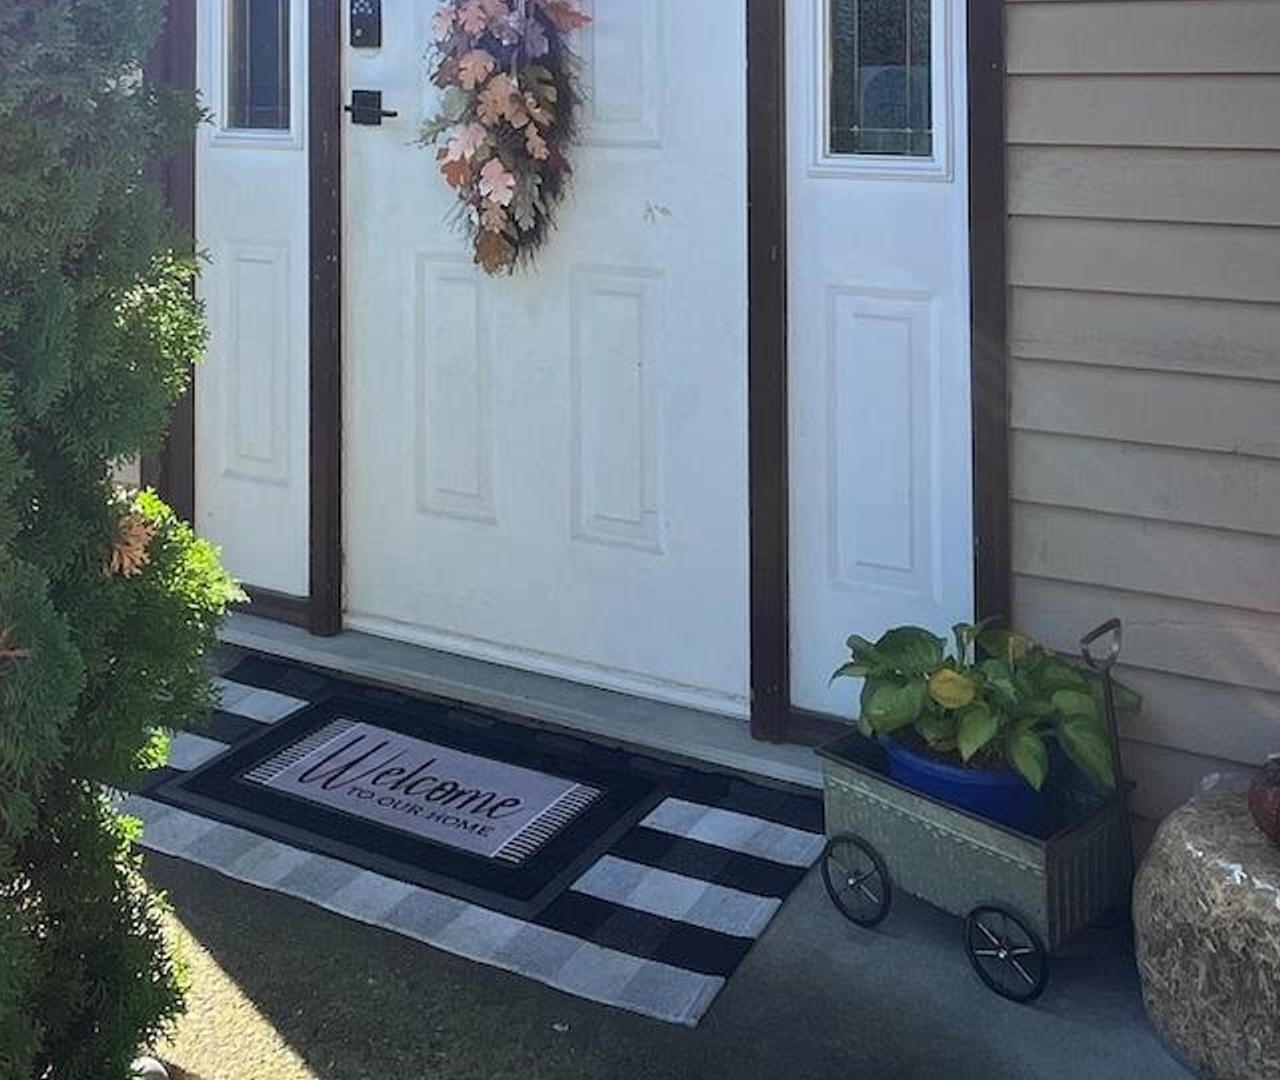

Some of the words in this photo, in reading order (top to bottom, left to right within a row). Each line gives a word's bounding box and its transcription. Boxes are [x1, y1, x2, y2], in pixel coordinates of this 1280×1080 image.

[297, 733, 527, 819] Welcome
[346, 785, 376, 800] TO
[377, 795, 425, 816] OUR
[426, 811, 497, 837] HOME
